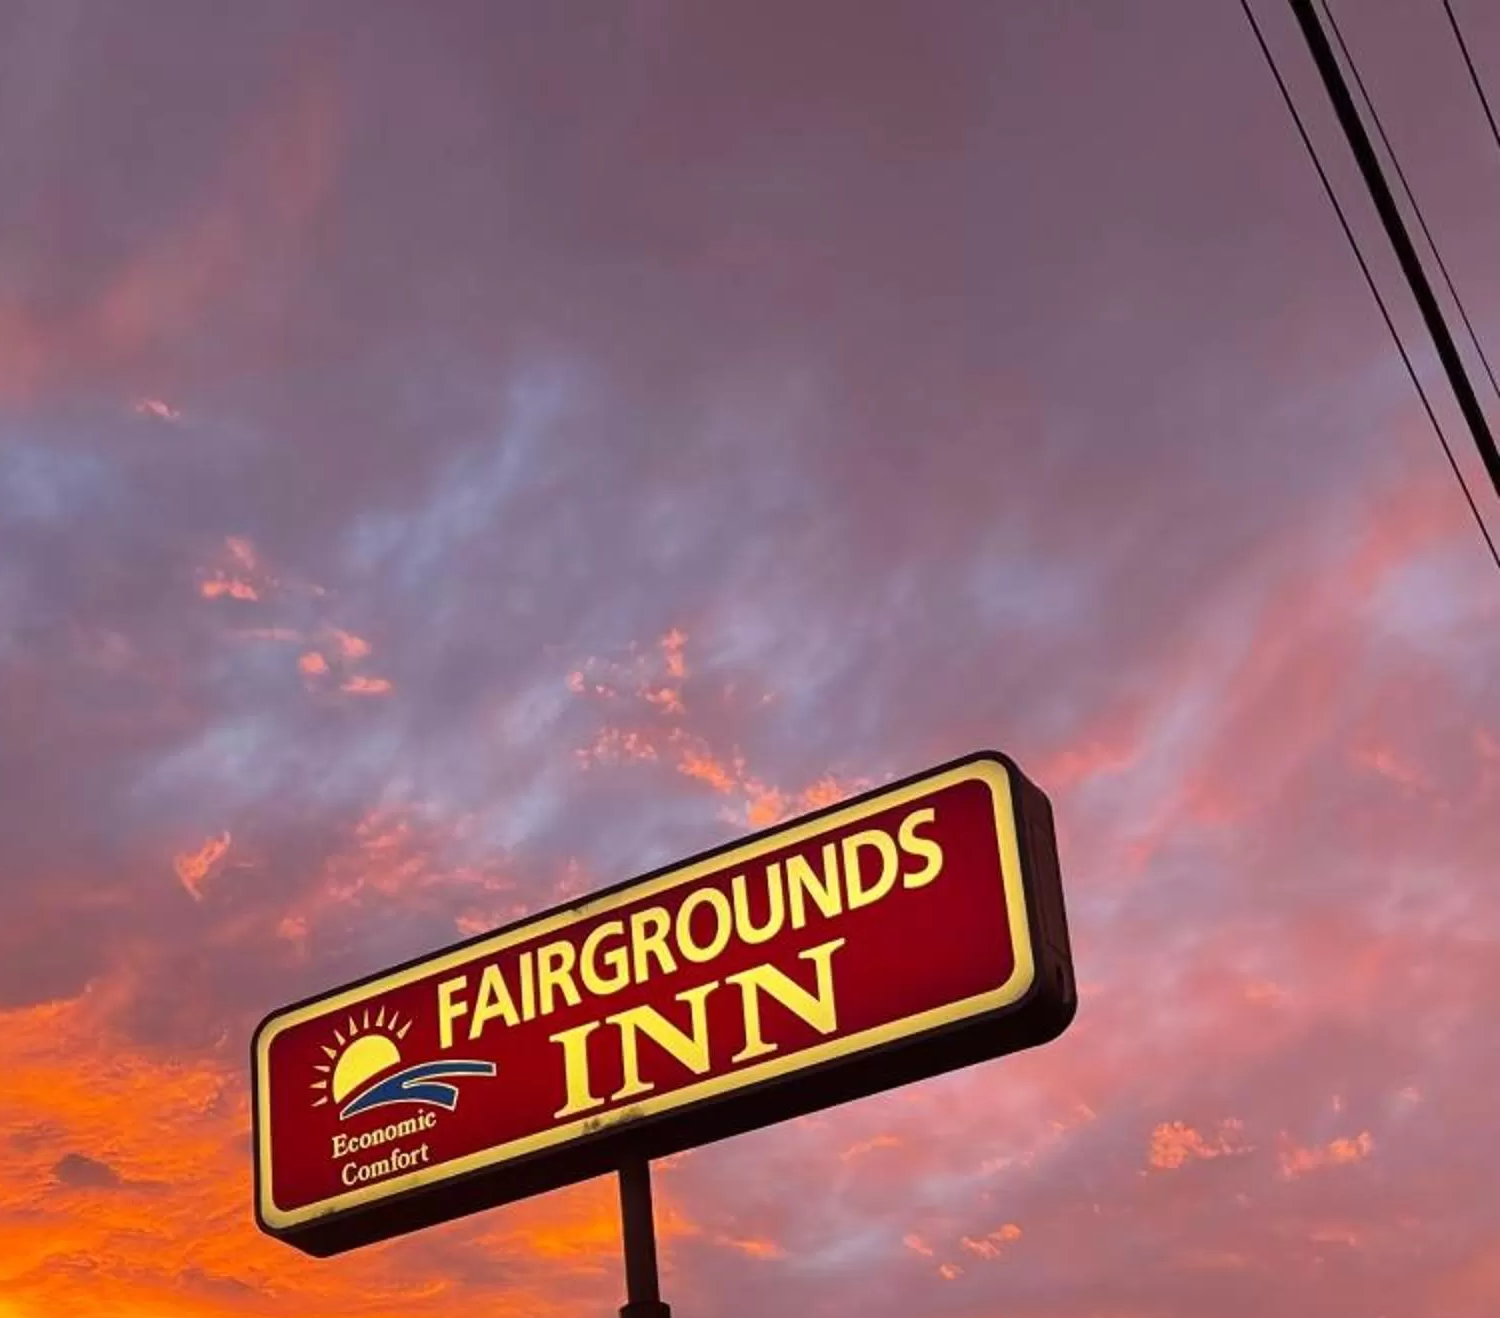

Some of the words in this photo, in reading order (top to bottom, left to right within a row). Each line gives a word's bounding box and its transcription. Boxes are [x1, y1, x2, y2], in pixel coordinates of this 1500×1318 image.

[437, 808, 943, 1048] FAIRGROUNDS
[550, 938, 845, 1118] INN
[332, 1108, 437, 1159] Economic
[341, 1143, 429, 1186] Comfort
